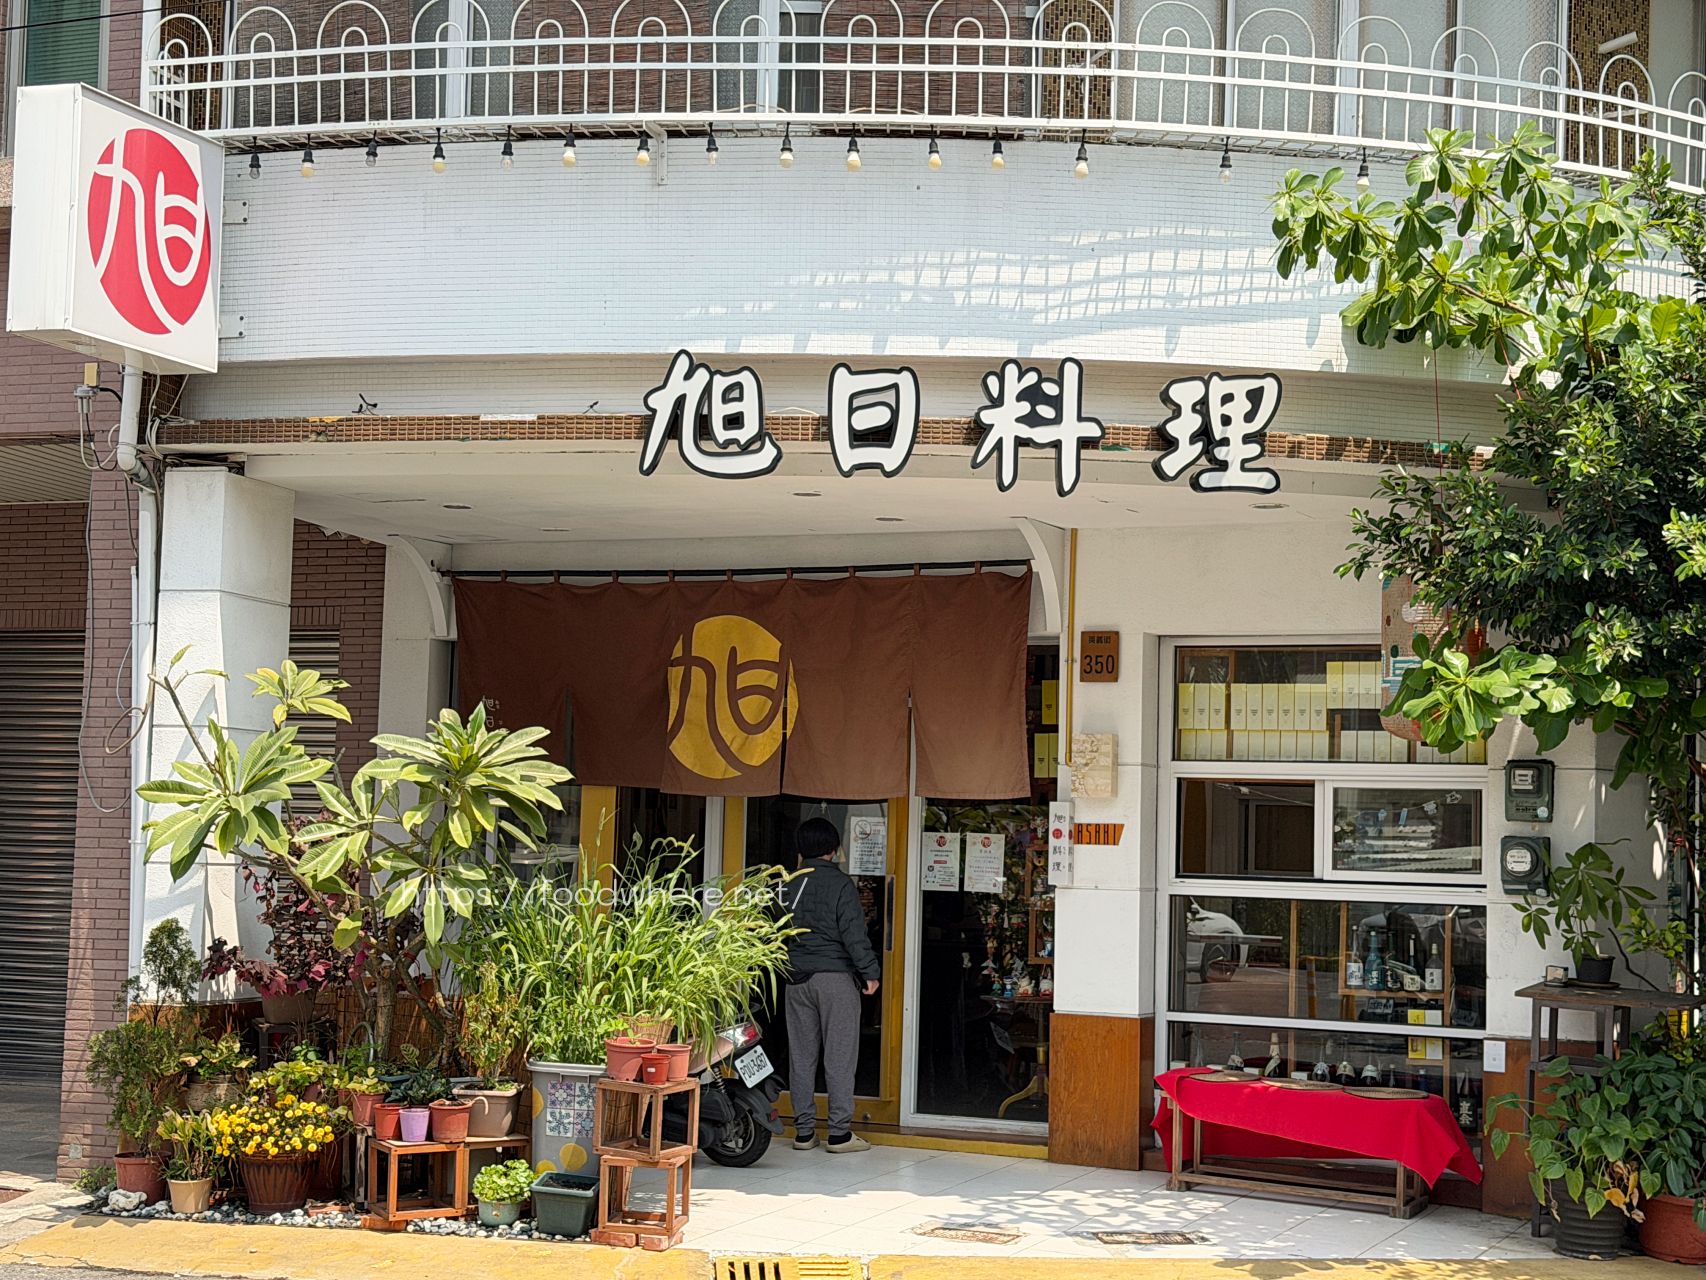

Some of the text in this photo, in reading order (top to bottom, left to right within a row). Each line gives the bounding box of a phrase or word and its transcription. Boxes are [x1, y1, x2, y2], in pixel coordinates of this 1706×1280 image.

[88, 128, 211, 334] 旭
[639, 349, 1282, 497] 旭日料理
[667, 615, 800, 780] 旭
[1083, 654, 1115, 674] 350
[1078, 824, 1116, 845] ASAHI
